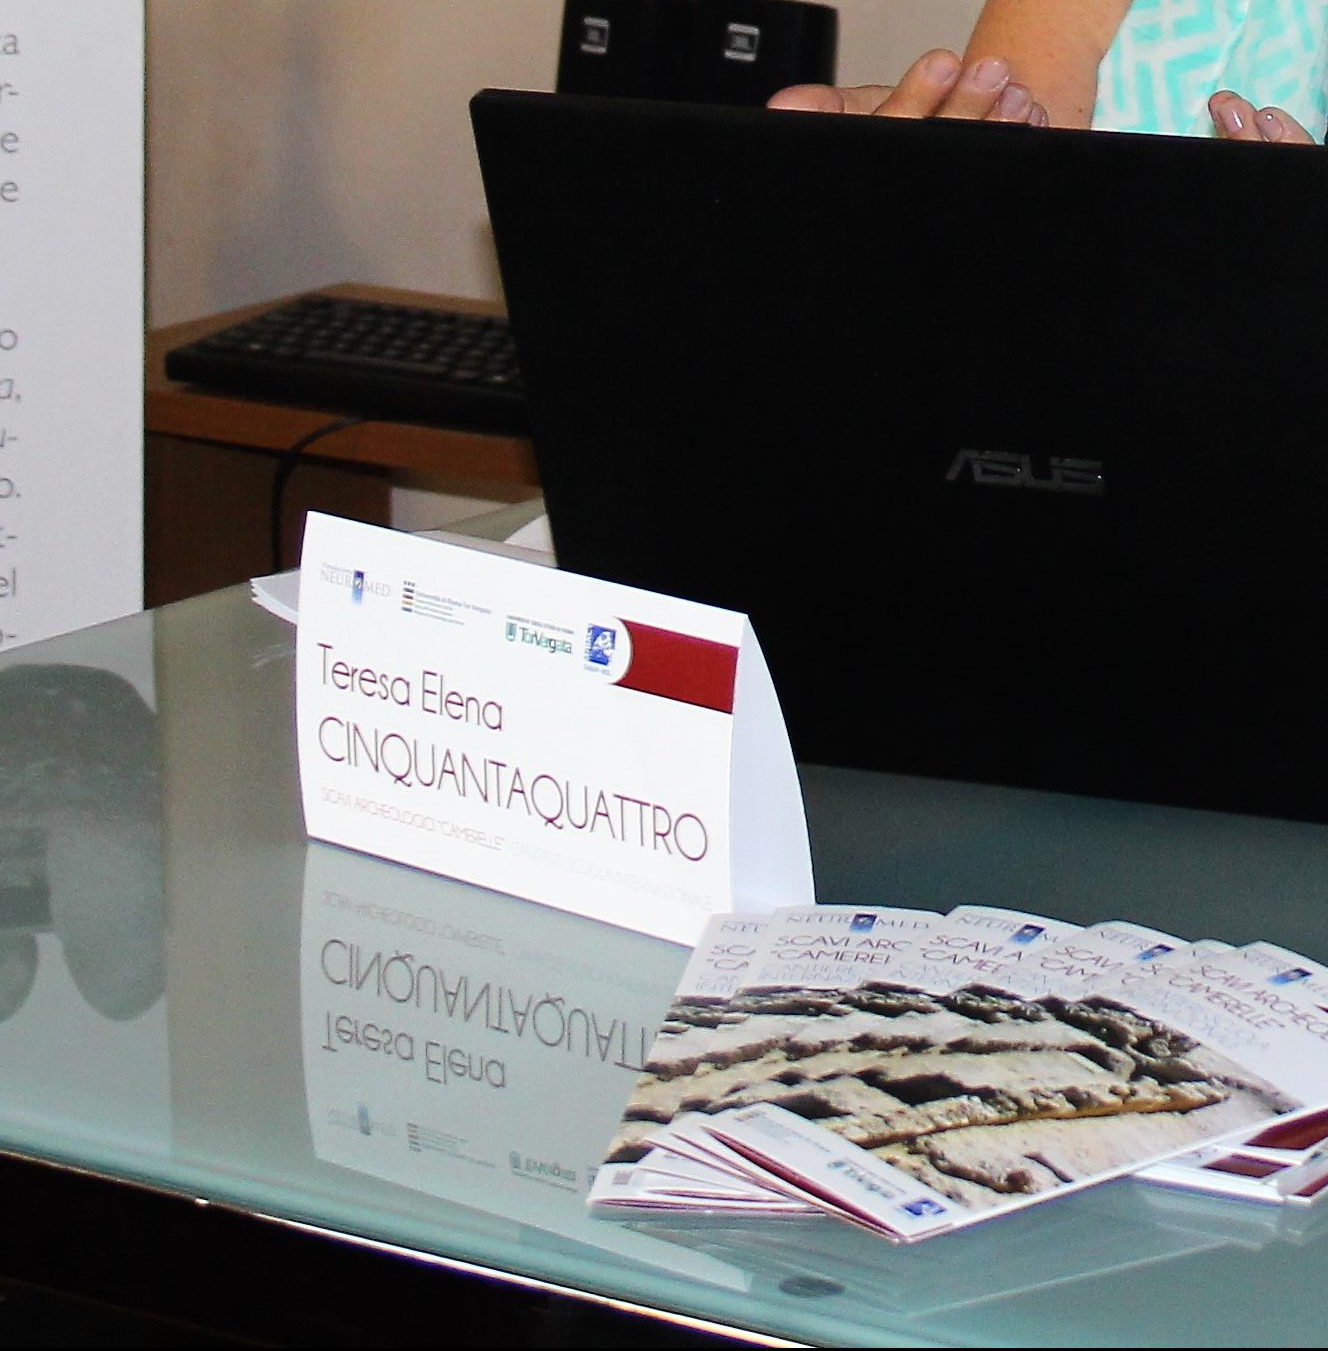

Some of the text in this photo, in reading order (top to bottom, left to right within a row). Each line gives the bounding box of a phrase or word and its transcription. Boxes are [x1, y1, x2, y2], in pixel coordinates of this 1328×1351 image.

[946, 449, 1104, 495] ASUS
[316, 642, 504, 732] Teresa Elena
[317, 716, 709, 863] CINQUANTAQUATTRO
[774, 935, 913, 952] SCAVI ARC
